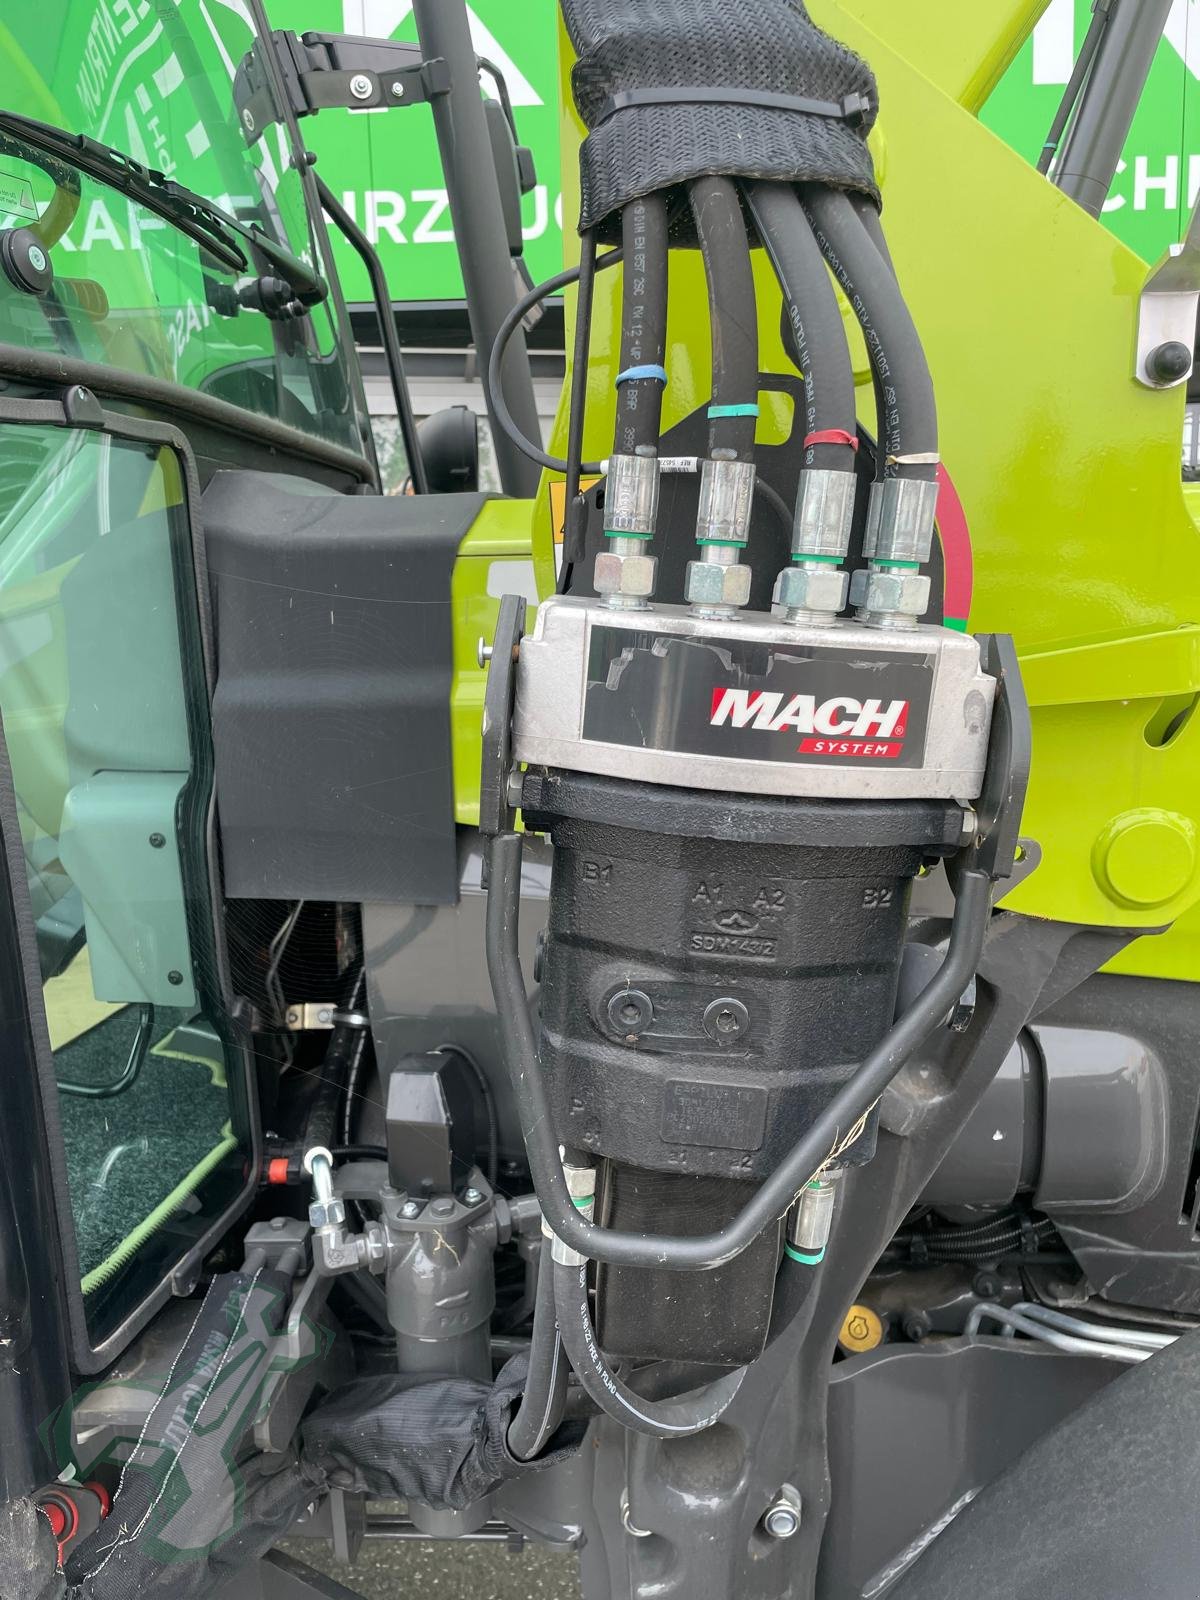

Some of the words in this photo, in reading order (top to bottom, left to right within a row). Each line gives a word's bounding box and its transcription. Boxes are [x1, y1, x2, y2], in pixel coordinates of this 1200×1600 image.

[634, 236, 645, 250] EN
[634, 253, 646, 273] 857
[633, 276, 645, 296] 2SC
[791, 305, 807, 348] POLAND
[802, 351, 809, 368] IN
[627, 390, 638, 411] BAR
[885, 386, 896, 406] 857
[890, 409, 899, 425] EN
[892, 430, 901, 451] DIN
[710, 688, 906, 737] MACH
[813, 741, 889, 756] SYSTEM
[582, 861, 613, 887] B1
[692, 881, 724, 904] A1
[752, 887, 786, 911] A2
[862, 888, 894, 908] B2
[600, 1370, 617, 1395] POLAND
